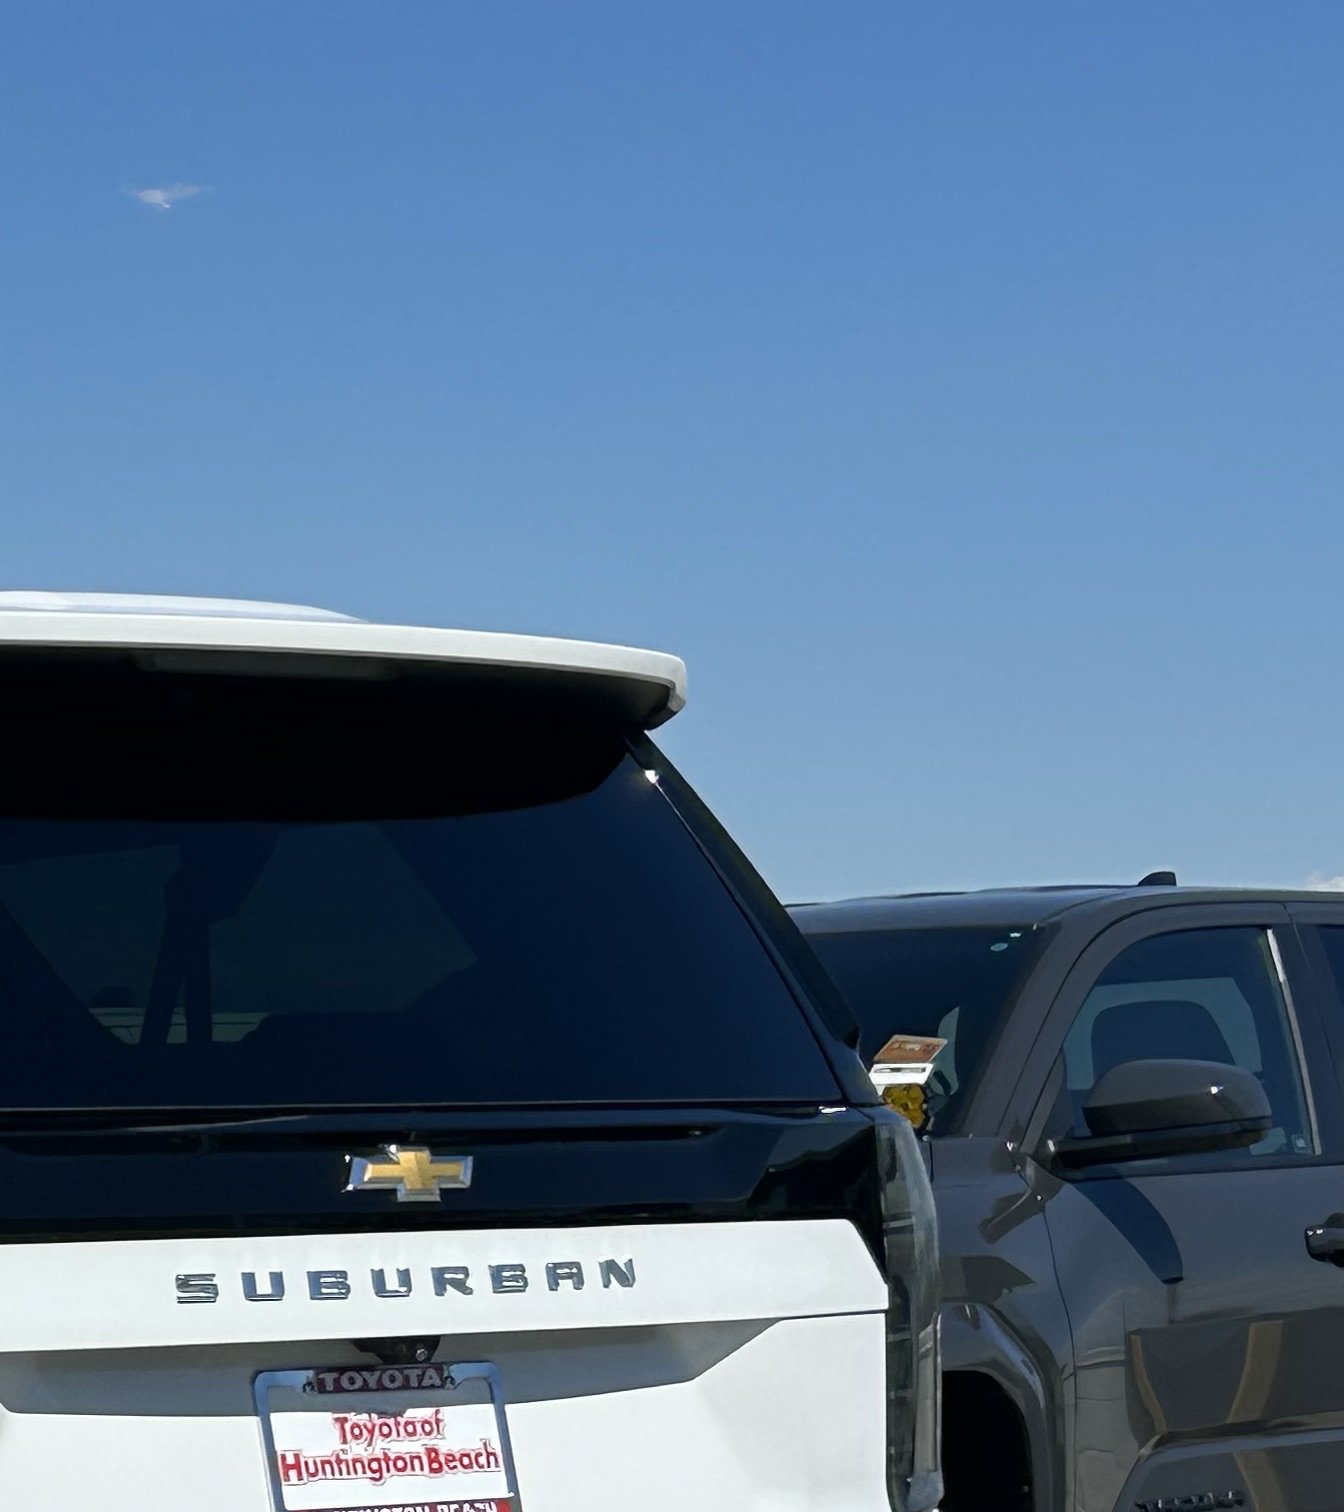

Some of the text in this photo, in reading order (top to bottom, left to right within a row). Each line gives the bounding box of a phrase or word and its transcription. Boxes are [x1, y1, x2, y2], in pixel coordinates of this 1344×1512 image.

[174, 1256, 636, 1304] SUBURBAN
[318, 1367, 442, 1391] TOYOTA
[332, 1408, 444, 1448] Toyota of
[279, 1442, 501, 1484] Huntington Beach
